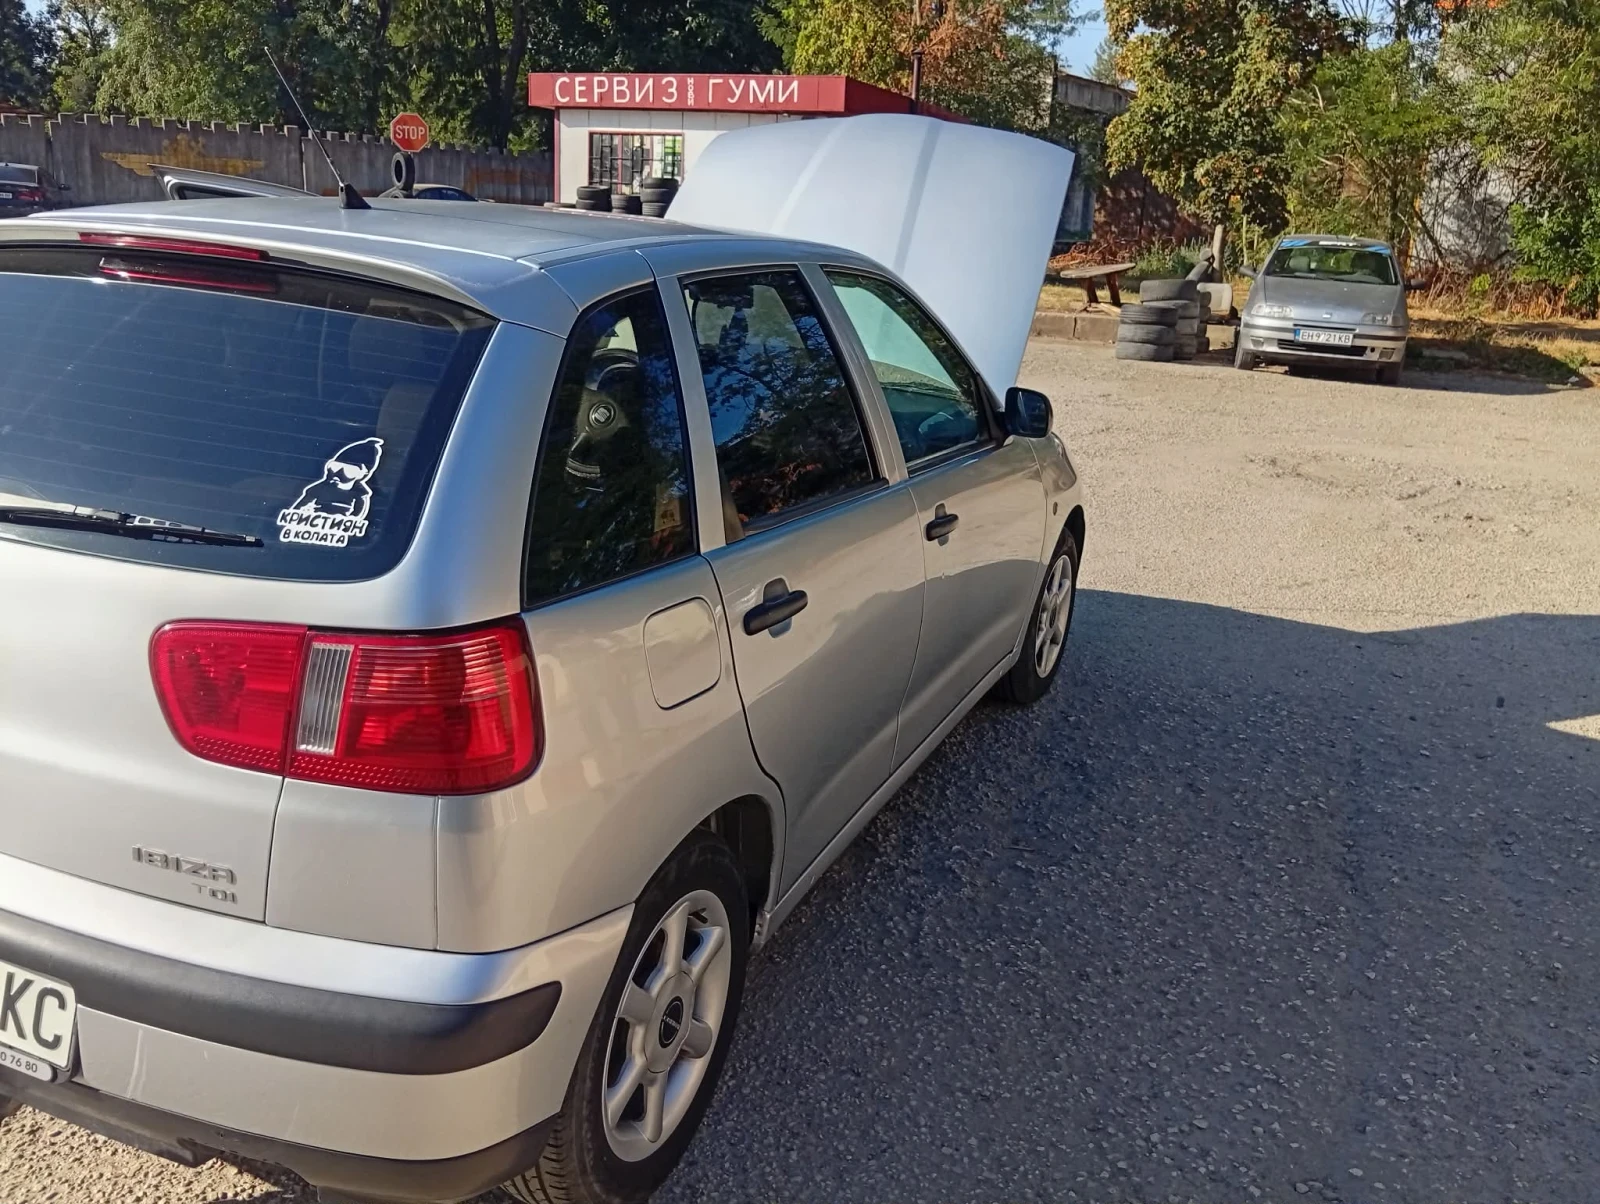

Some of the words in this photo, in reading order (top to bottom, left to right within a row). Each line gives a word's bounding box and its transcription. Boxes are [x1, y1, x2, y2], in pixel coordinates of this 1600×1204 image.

[554, 76, 678, 104] СЕРВИЗ
[687, 77, 695, 106] НОВИ
[708, 78, 799, 104] ГУМИ
[395, 125, 425, 140] STOP
[279, 511, 366, 535] КРИСТИЯН
[282, 528, 292, 539] В
[294, 529, 346, 545] КОЛАТА
[131, 844, 238, 885] IBIZA
[191, 882, 238, 904] TDI
[10, 1054, 22, 1068] 76
[25, 1060, 38, 1073] 80
